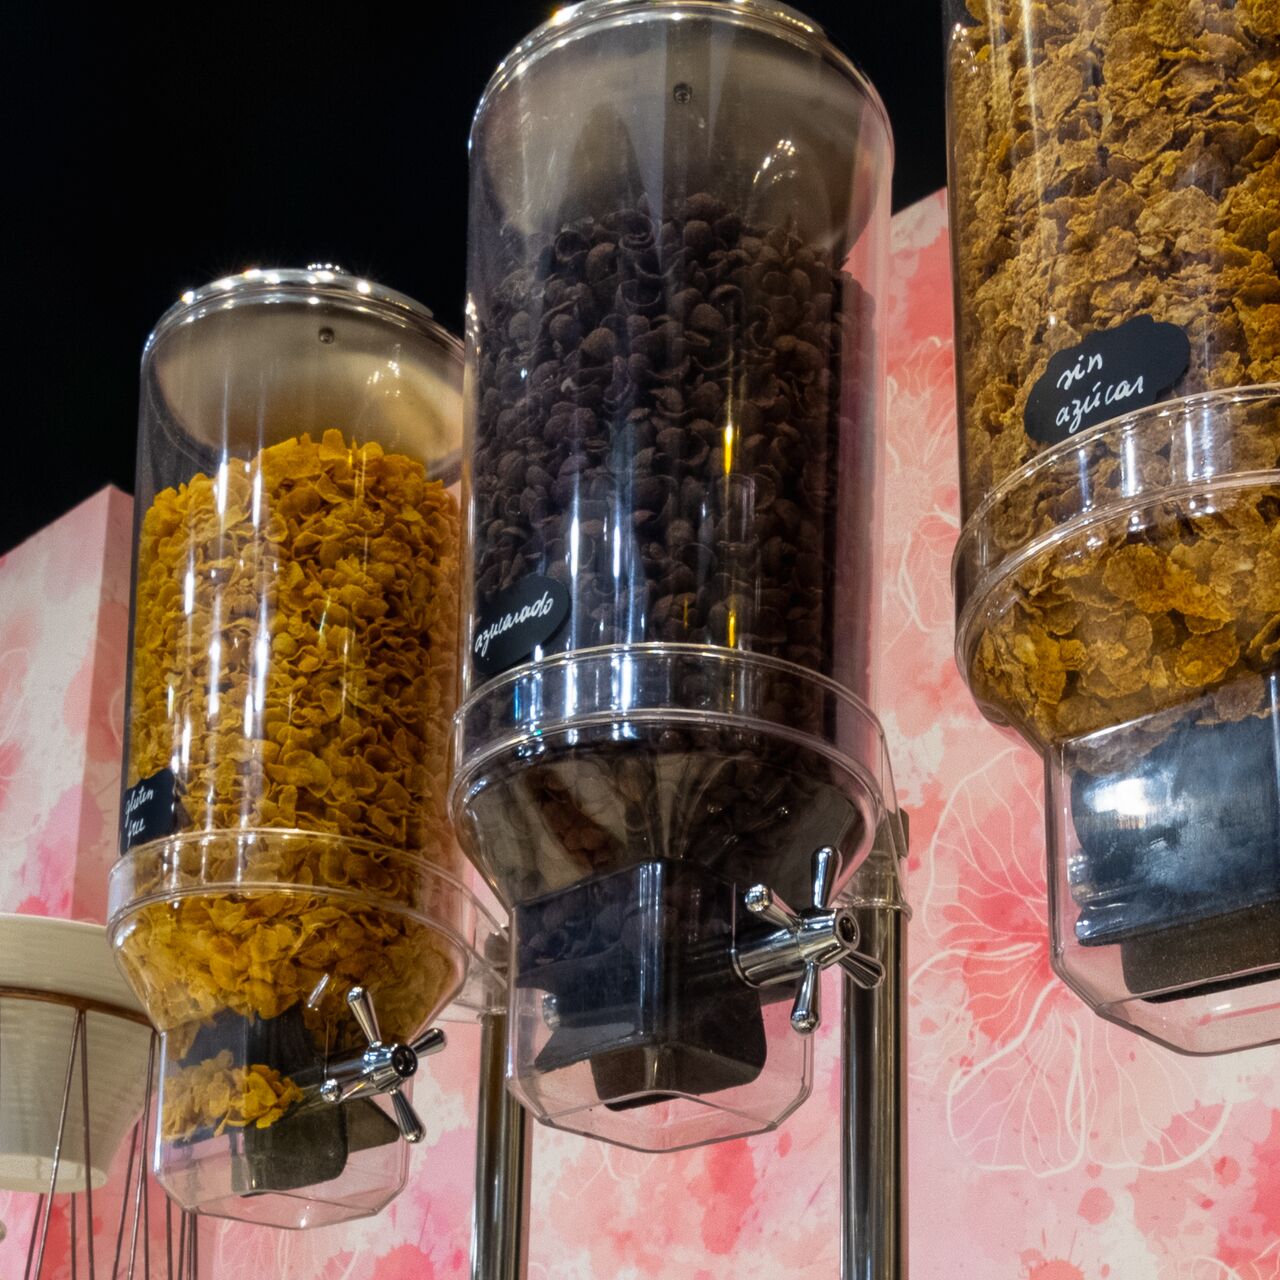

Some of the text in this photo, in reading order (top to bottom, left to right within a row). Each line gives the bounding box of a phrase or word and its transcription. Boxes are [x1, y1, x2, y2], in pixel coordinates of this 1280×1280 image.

[1056, 352, 1103, 391] sin
[1055, 375, 1144, 434] azúcar
[124, 786, 154, 828] gluten
[127, 818, 146, 848] free
